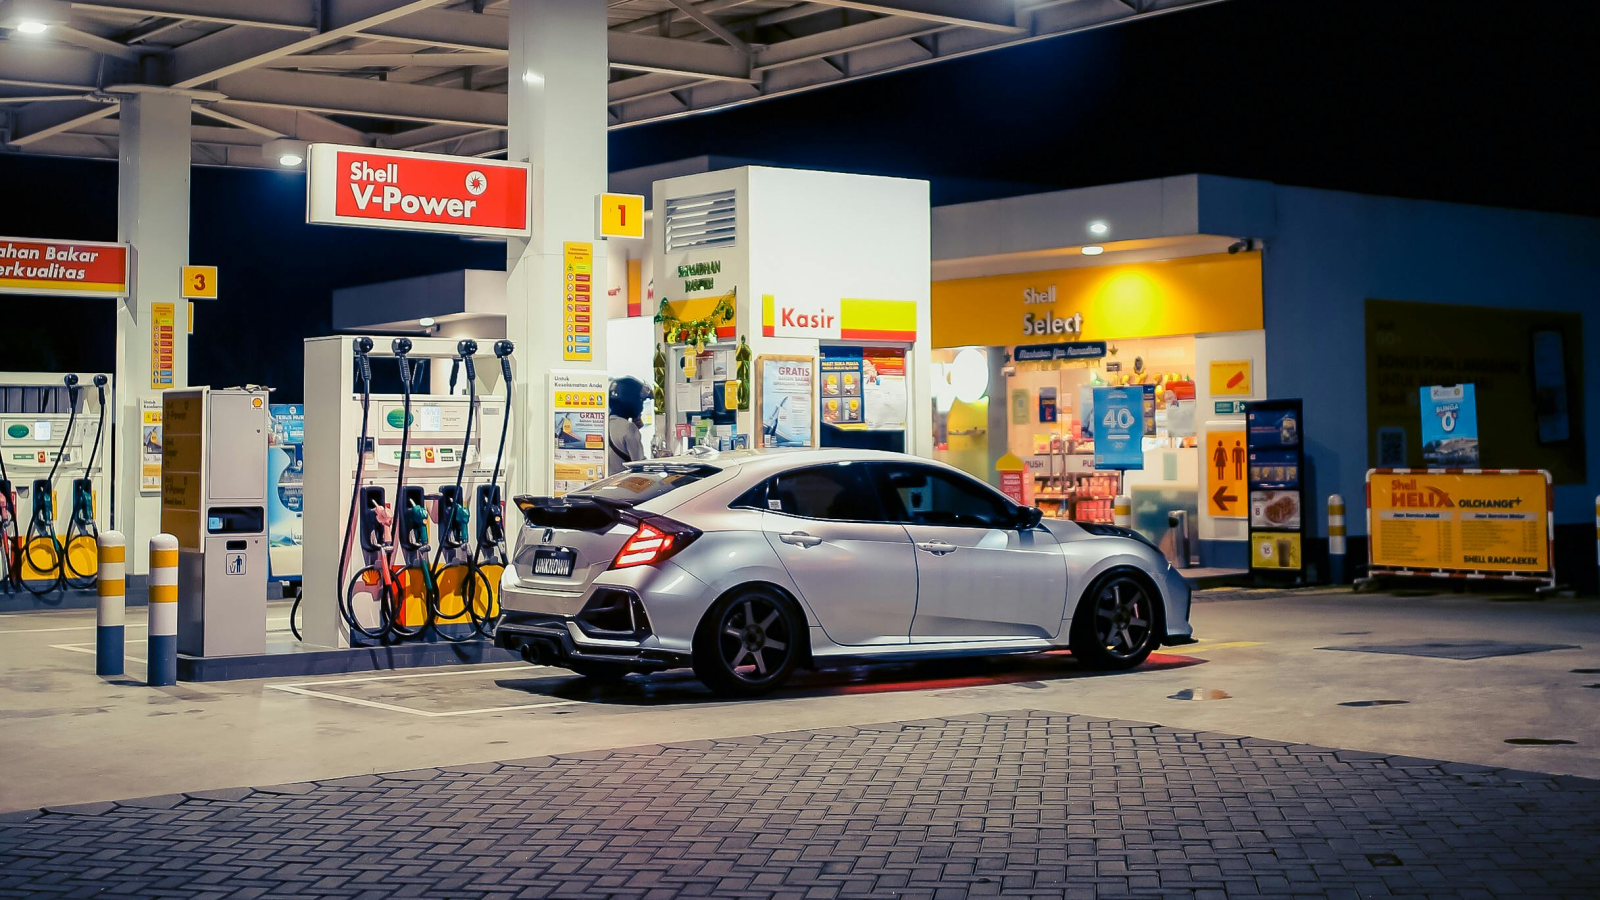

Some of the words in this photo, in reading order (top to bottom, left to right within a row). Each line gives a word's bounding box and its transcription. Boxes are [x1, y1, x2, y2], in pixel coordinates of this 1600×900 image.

[350, 161, 398, 184] Shell
[350, 183, 477, 218] V-Power
[617, 204, 626, 226] 1
[45, 246, 98, 262] Bakar
[193, 274, 206, 291] 3
[1023, 285, 1056, 304] Shell
[782, 308, 834, 329] Kasir
[1022, 312, 1082, 335] Select
[778, 366, 810, 376] GRATIS
[579, 412, 604, 420] GRATIS
[1436, 403, 1459, 413] BUNGA
[1025, 460, 1044, 468] PUSH
[1392, 479, 1416, 491] Shell
[1392, 490, 1455, 507] HELIX
[535, 558, 569, 575] UNKNOWN
[1463, 555, 1486, 564] SHELL
[1488, 556, 1538, 565] RANCAEKEK
